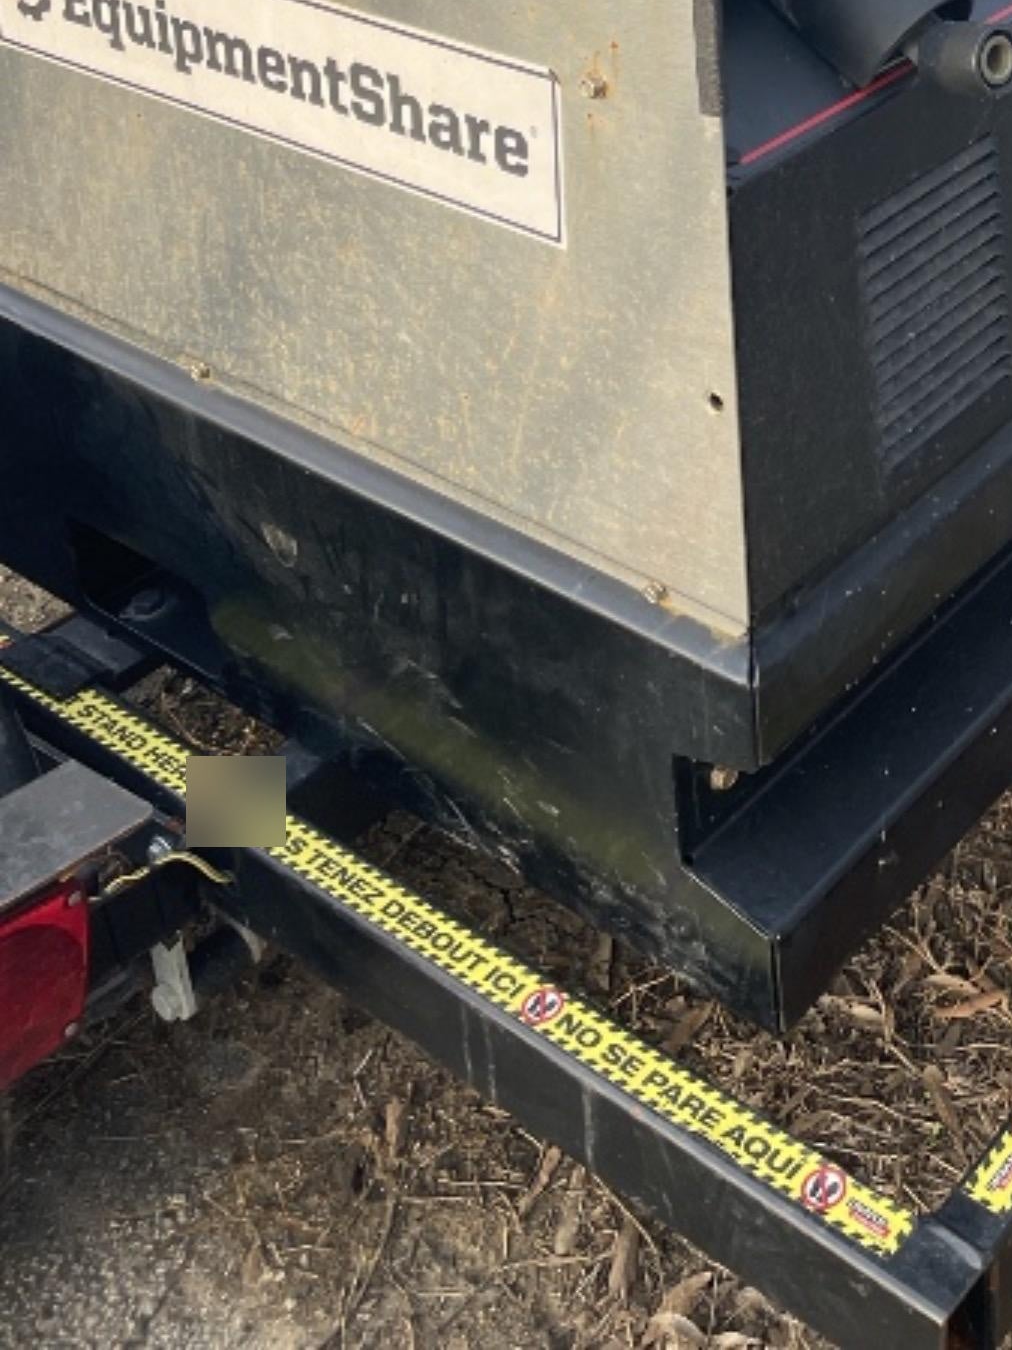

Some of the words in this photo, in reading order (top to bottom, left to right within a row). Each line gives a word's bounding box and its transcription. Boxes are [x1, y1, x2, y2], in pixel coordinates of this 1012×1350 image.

[77, 704, 148, 750] STAND
[306, 849, 386, 905] TENEZ
[381, 899, 490, 971] DEBOUT
[482, 965, 527, 999] ICI
[555, 1012, 601, 1049] NO
[599, 1041, 642, 1077] SE
[639, 1069, 728, 1129] PARE
